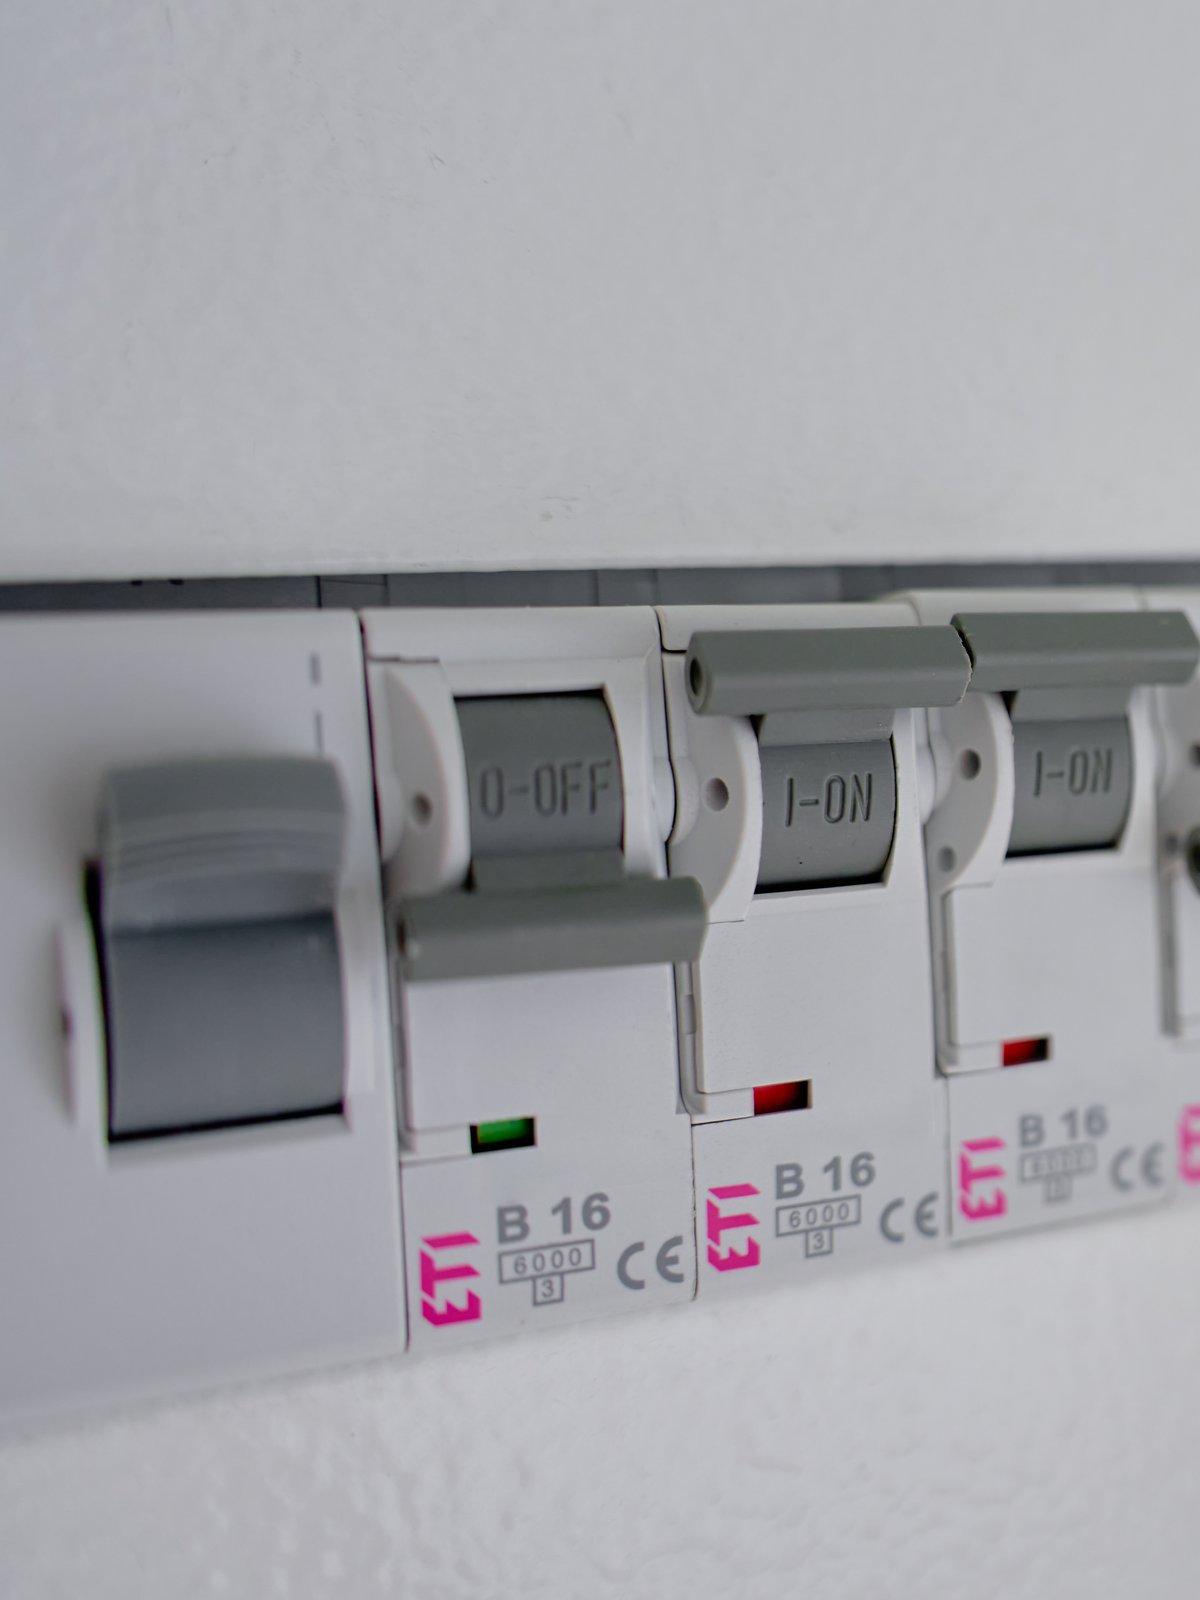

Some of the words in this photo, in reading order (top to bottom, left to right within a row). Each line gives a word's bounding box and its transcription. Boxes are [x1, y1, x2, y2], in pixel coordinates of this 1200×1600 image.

[1034, 747, 1113, 797] I-ON
[785, 772, 873, 827] I-ON
[1019, 1113, 1045, 1148] B
[1060, 1105, 1109, 1140] 16
[775, 1163, 805, 1199] B
[822, 1152, 877, 1192] 16
[959, 1136, 1007, 1222] ETI
[497, 1204, 530, 1244] B
[550, 1192, 612, 1236] 16
[706, 1183, 761, 1272] ETI
[788, 1203, 851, 1229] 6000
[419, 1231, 482, 1328] ETI
[513, 1248, 583, 1277] 6000
[540, 1280, 555, 1299] 3
